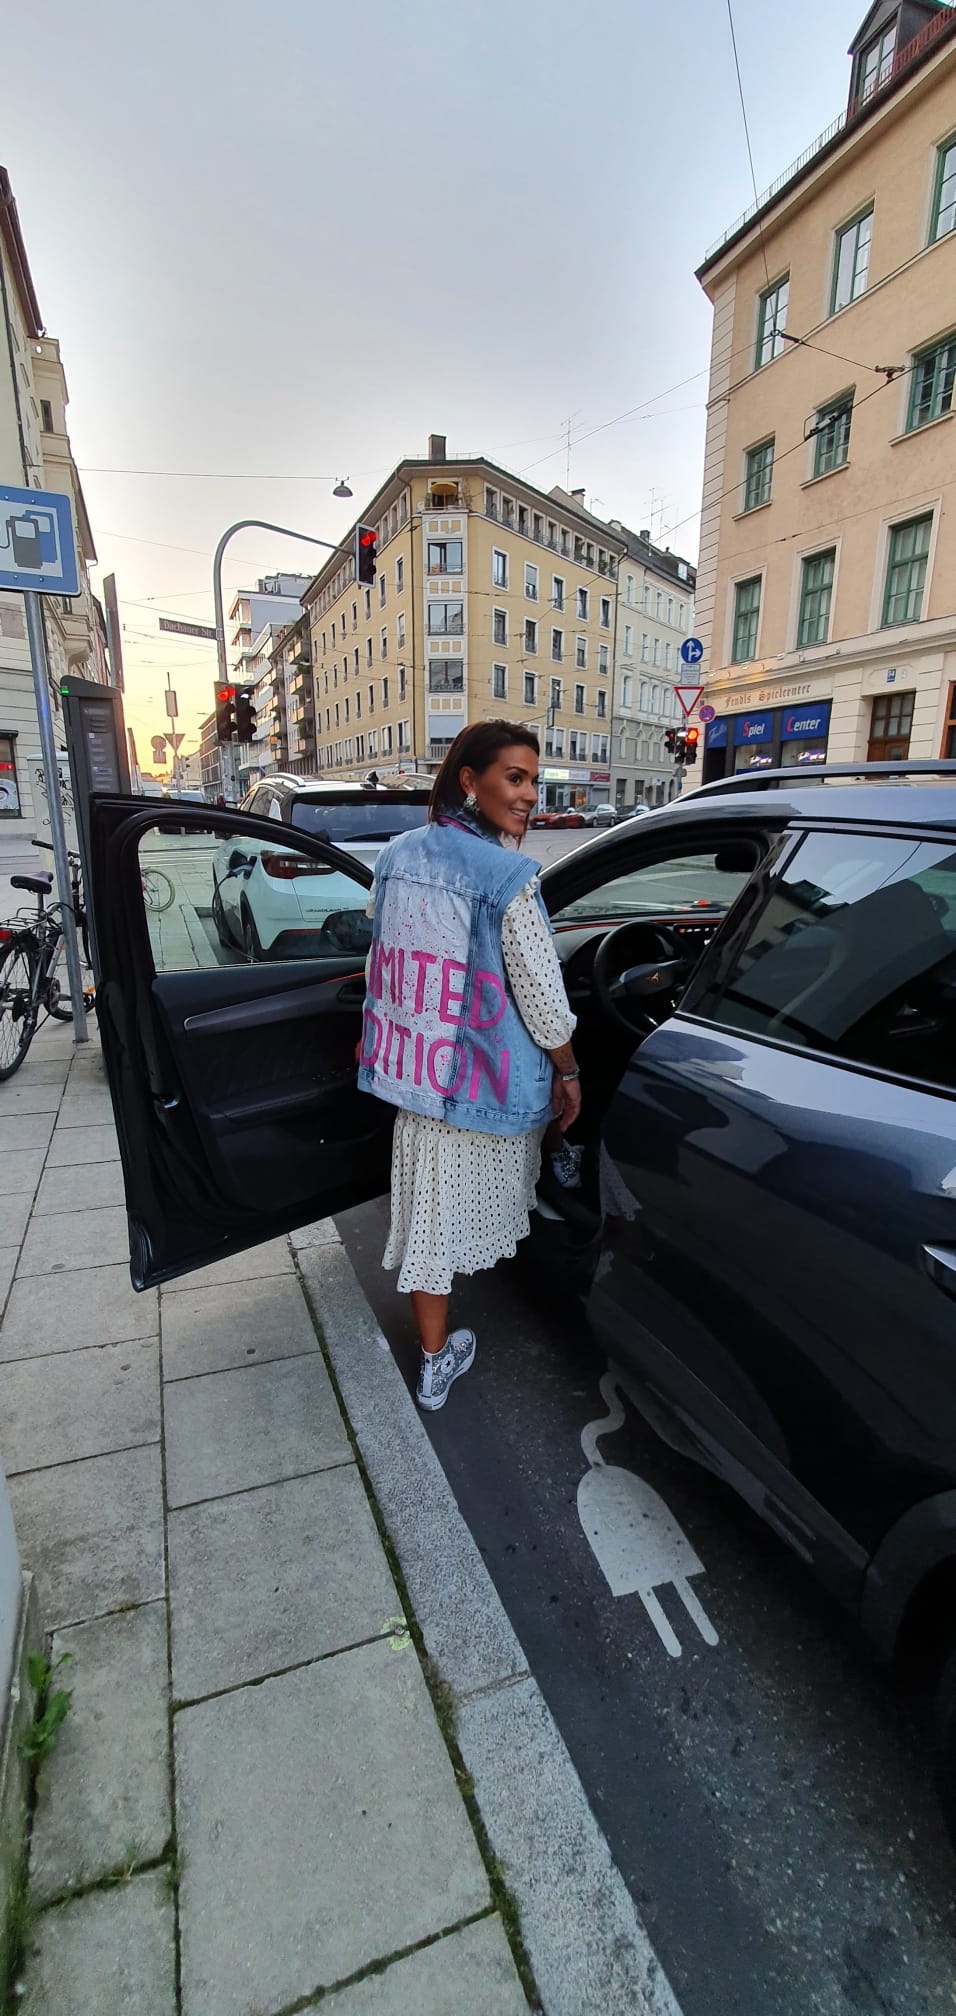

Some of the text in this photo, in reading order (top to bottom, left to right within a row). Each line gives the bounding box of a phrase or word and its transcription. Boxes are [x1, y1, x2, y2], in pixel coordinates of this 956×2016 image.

[163, 620, 199, 636] Dachauer
[758, 683, 812, 703] Spielcenter
[743, 720, 765, 738] Spiel
[786, 716, 821, 734] Center
[368, 937, 508, 1030] IMITED
[359, 1007, 511, 1106] DITION
